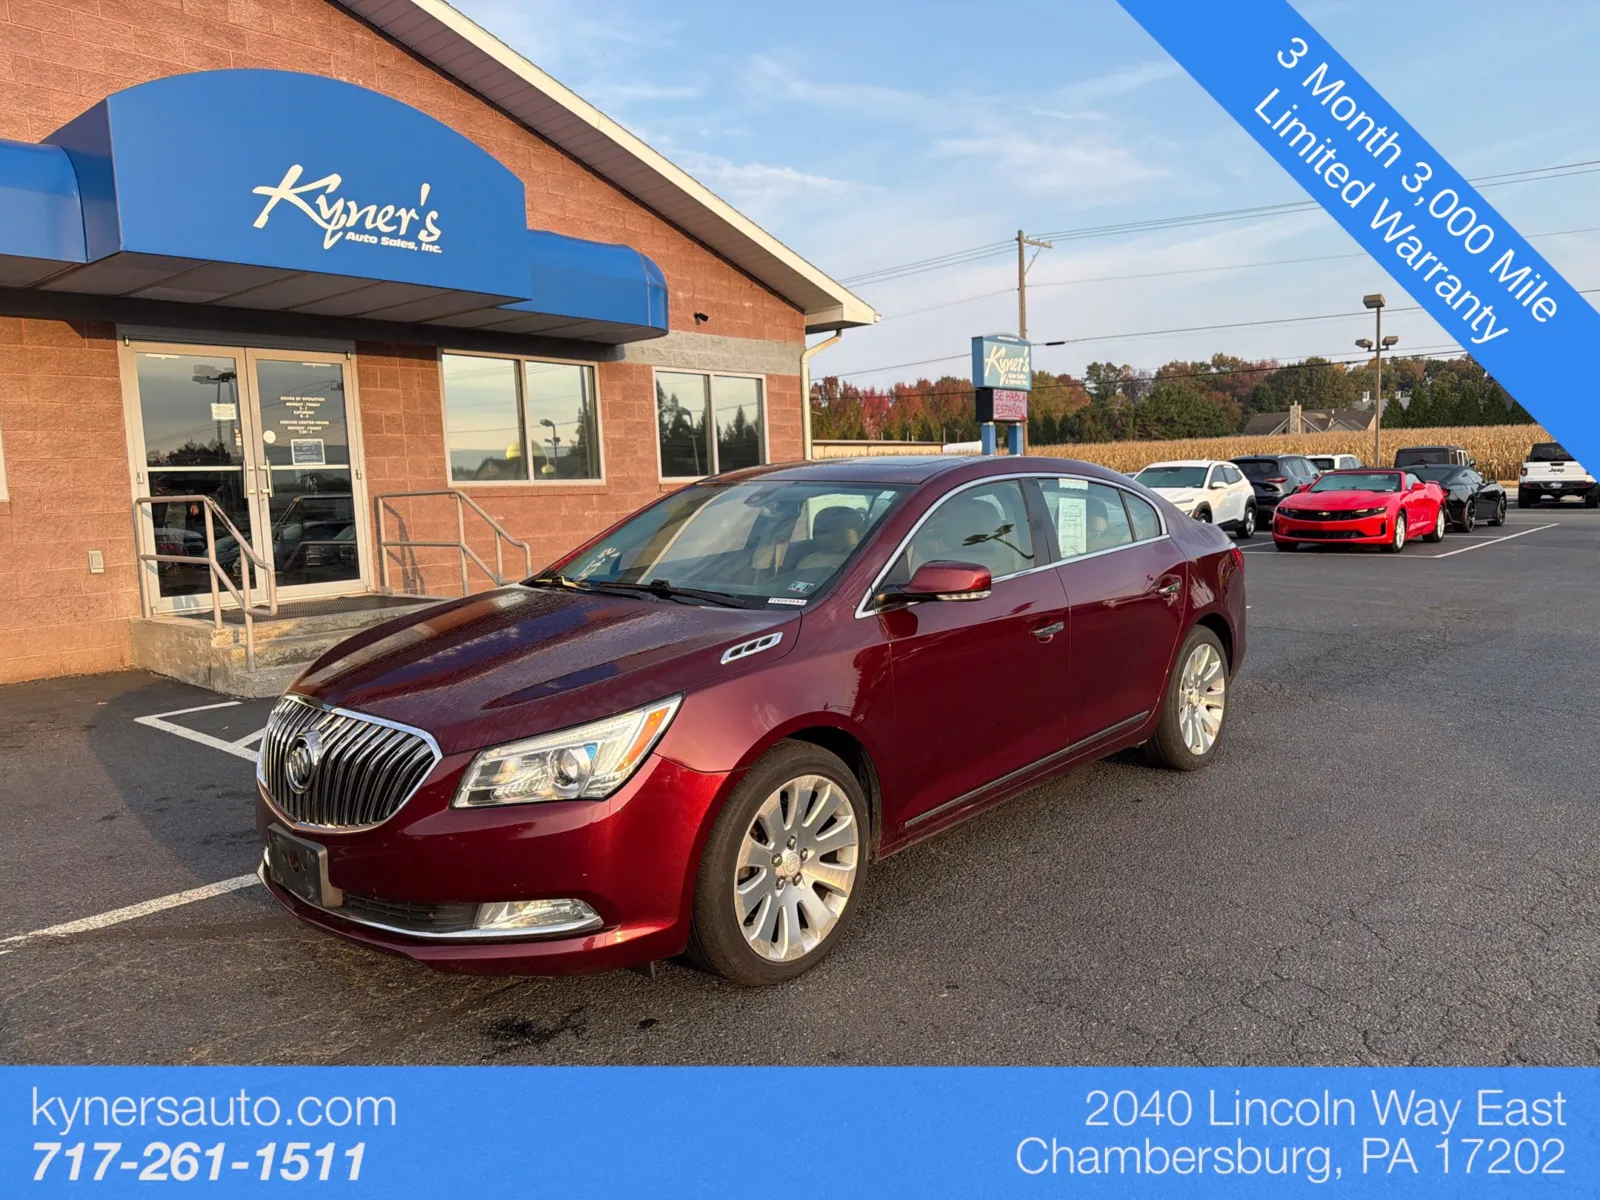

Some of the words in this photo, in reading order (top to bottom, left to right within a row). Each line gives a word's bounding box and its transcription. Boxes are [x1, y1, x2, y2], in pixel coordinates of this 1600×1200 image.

[252, 163, 442, 250] Kyner's
[345, 231, 378, 244] Auto
[380, 236, 418, 251] Sales,
[421, 242, 443, 253] Inc.
[985, 345, 1029, 386] Kyner's
[995, 391, 1003, 400] SE
[1006, 391, 1026, 402] HABLA
